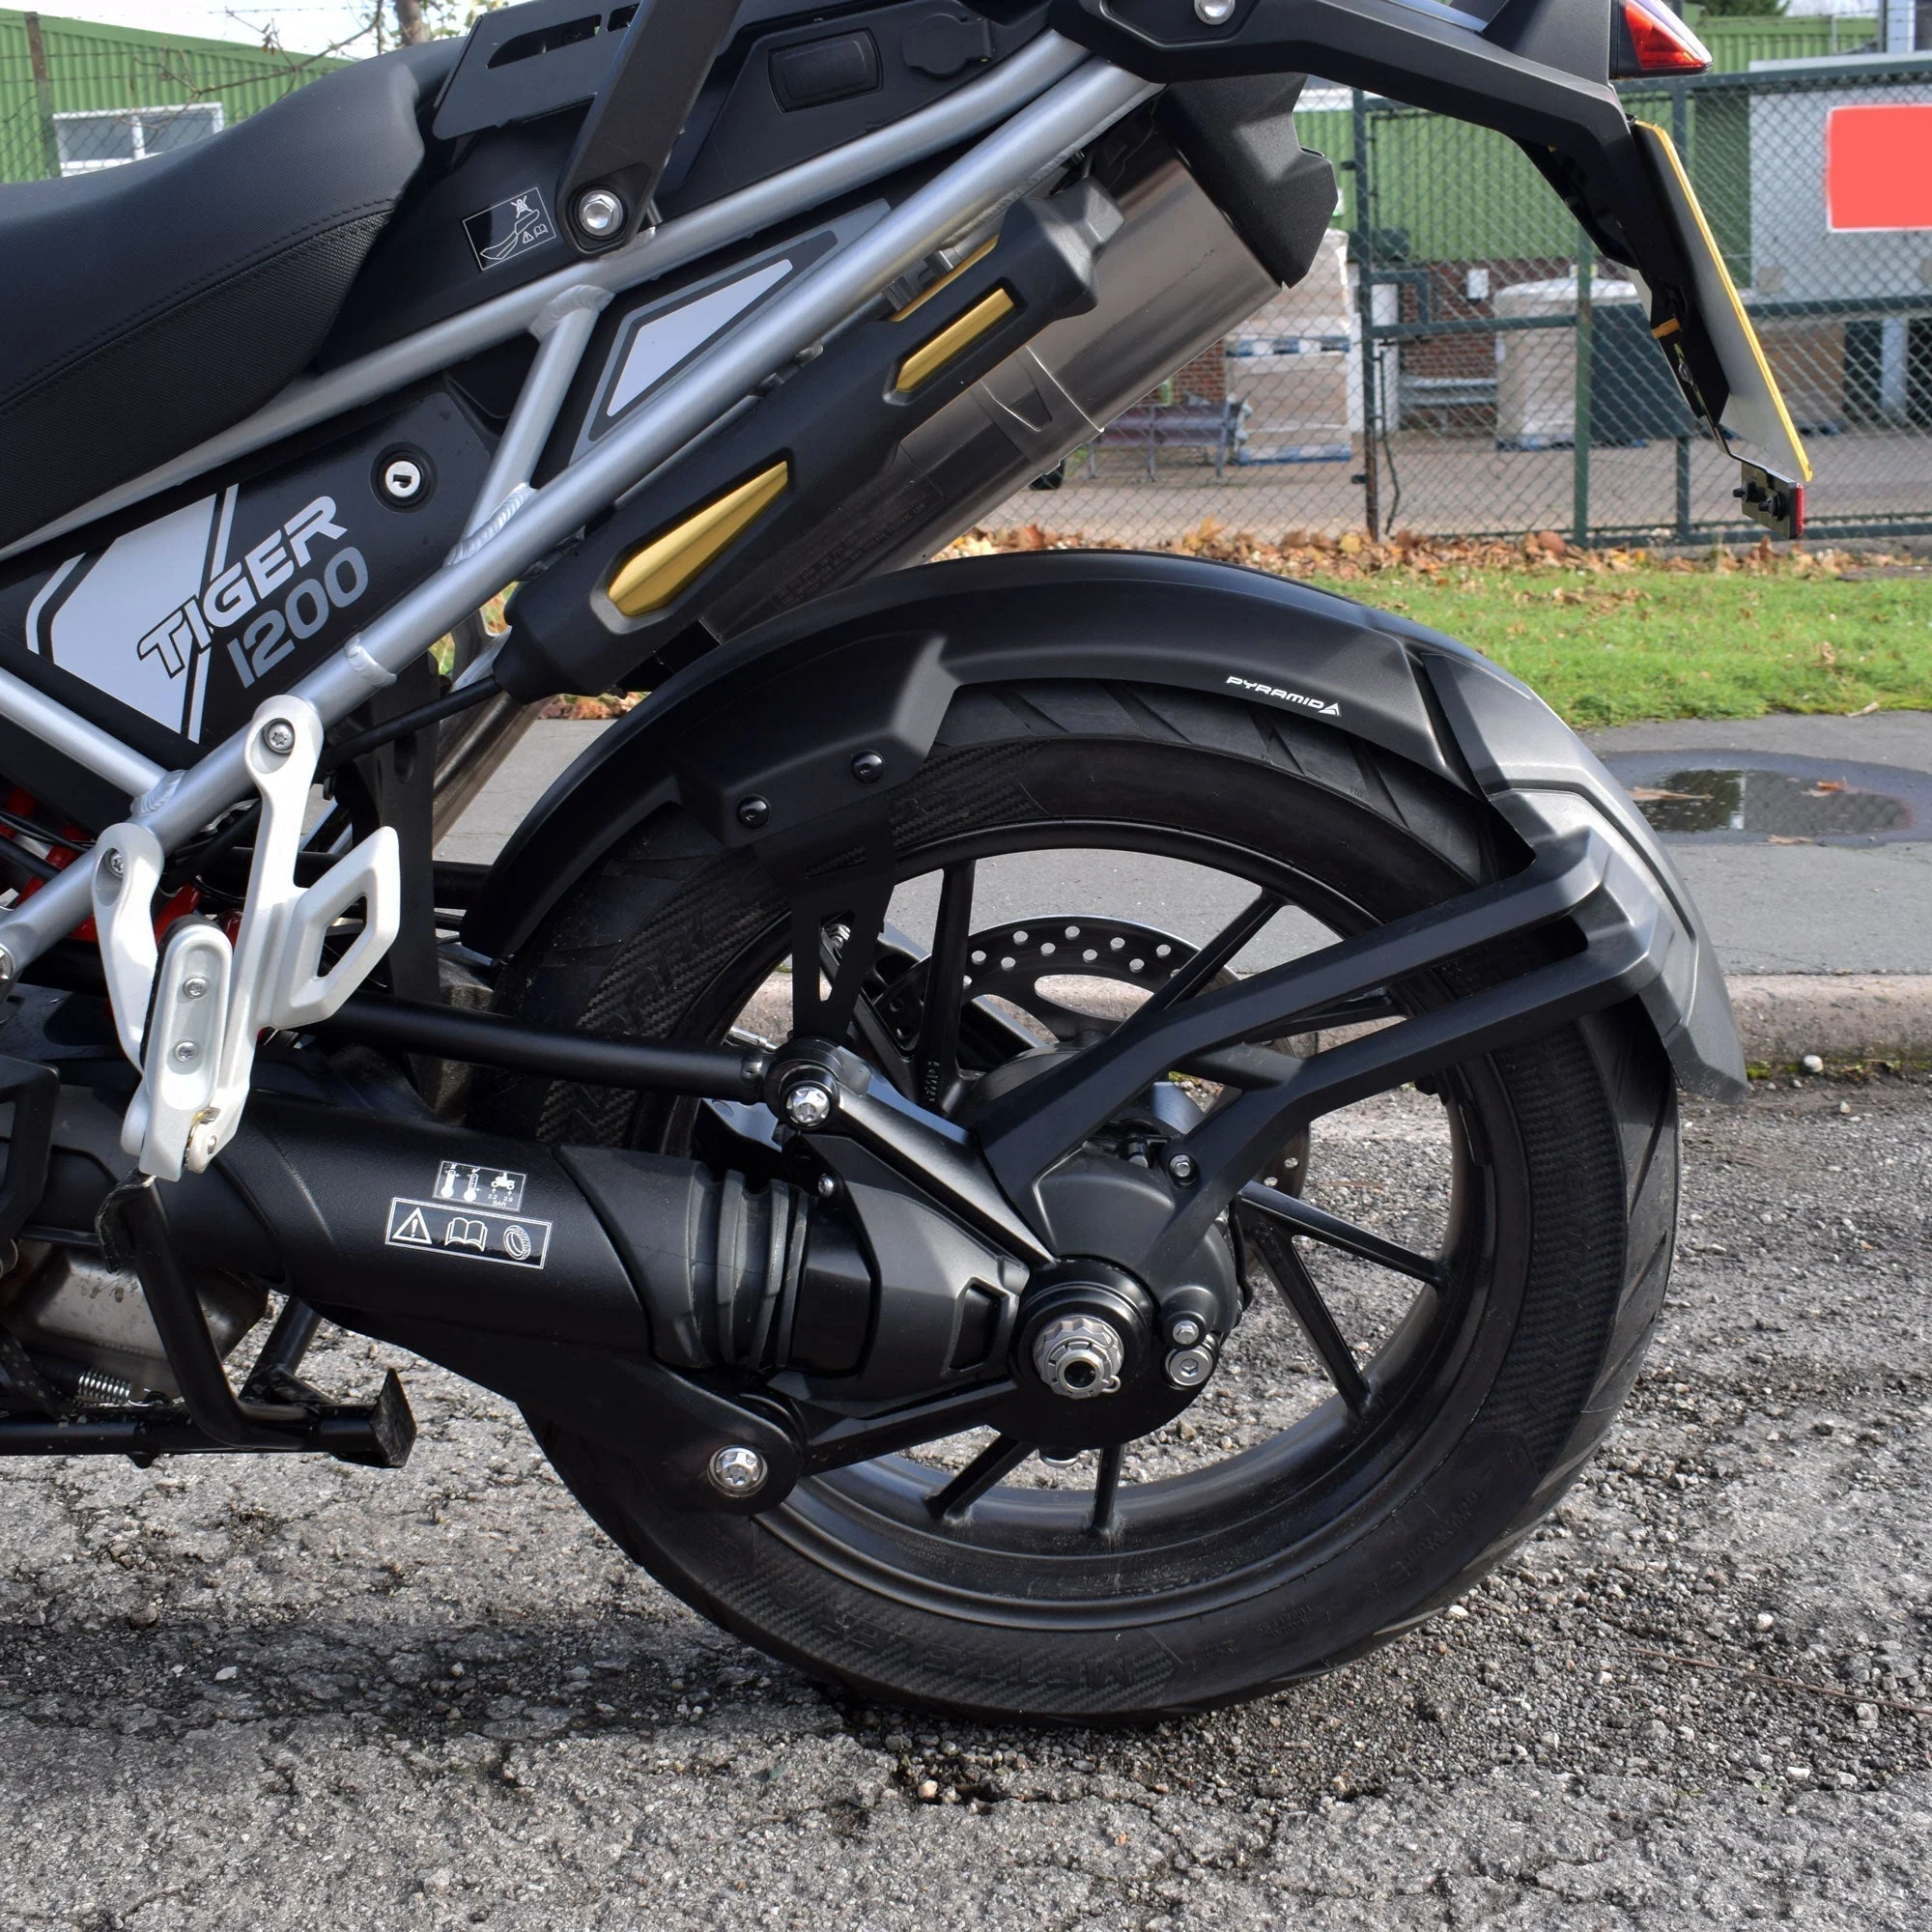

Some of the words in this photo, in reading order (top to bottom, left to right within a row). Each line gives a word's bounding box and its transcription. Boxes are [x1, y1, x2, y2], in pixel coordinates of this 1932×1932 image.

[136, 496, 348, 679] TIGER
[227, 546, 369, 688] 1200
[1226, 675, 1324, 709] PYRAMID
